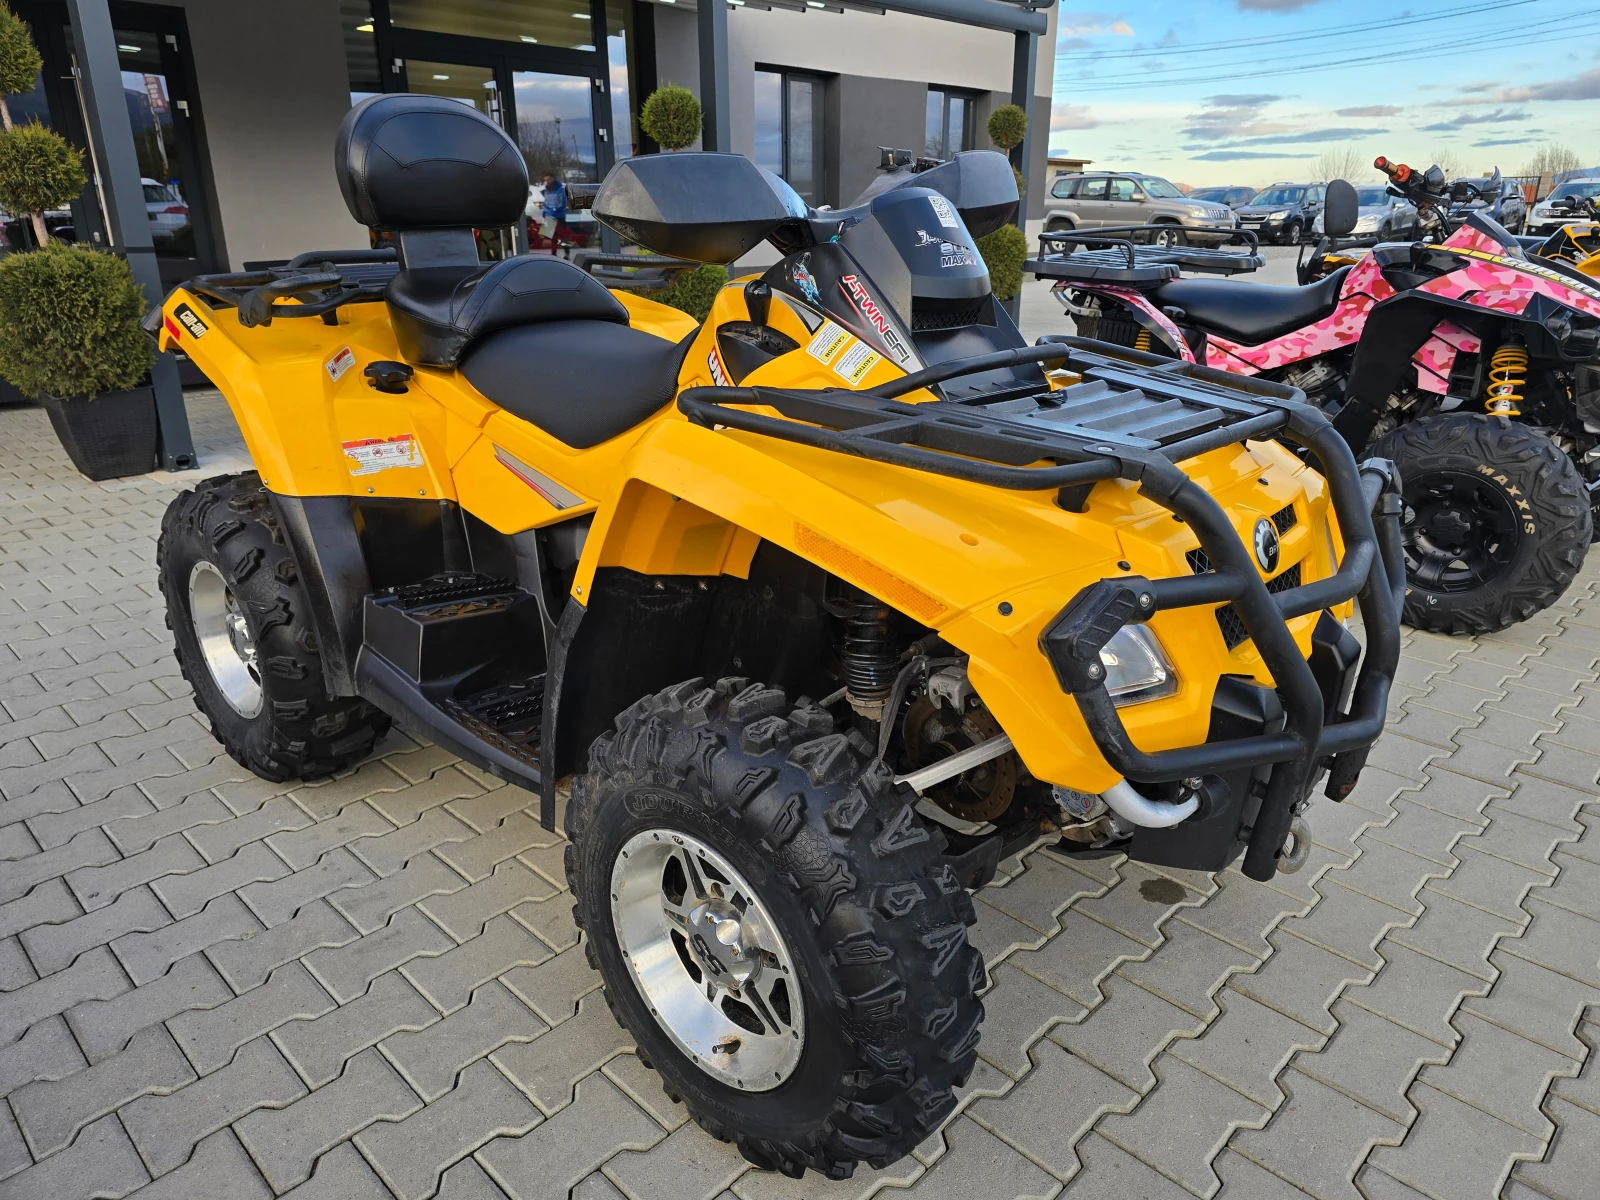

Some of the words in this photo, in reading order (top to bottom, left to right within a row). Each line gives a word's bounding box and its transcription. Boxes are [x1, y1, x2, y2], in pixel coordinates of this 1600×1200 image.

[824, 335, 845, 358] CAUTION
[853, 356, 874, 378] CAUTION
[1476, 464, 1536, 535] MAXXIS
